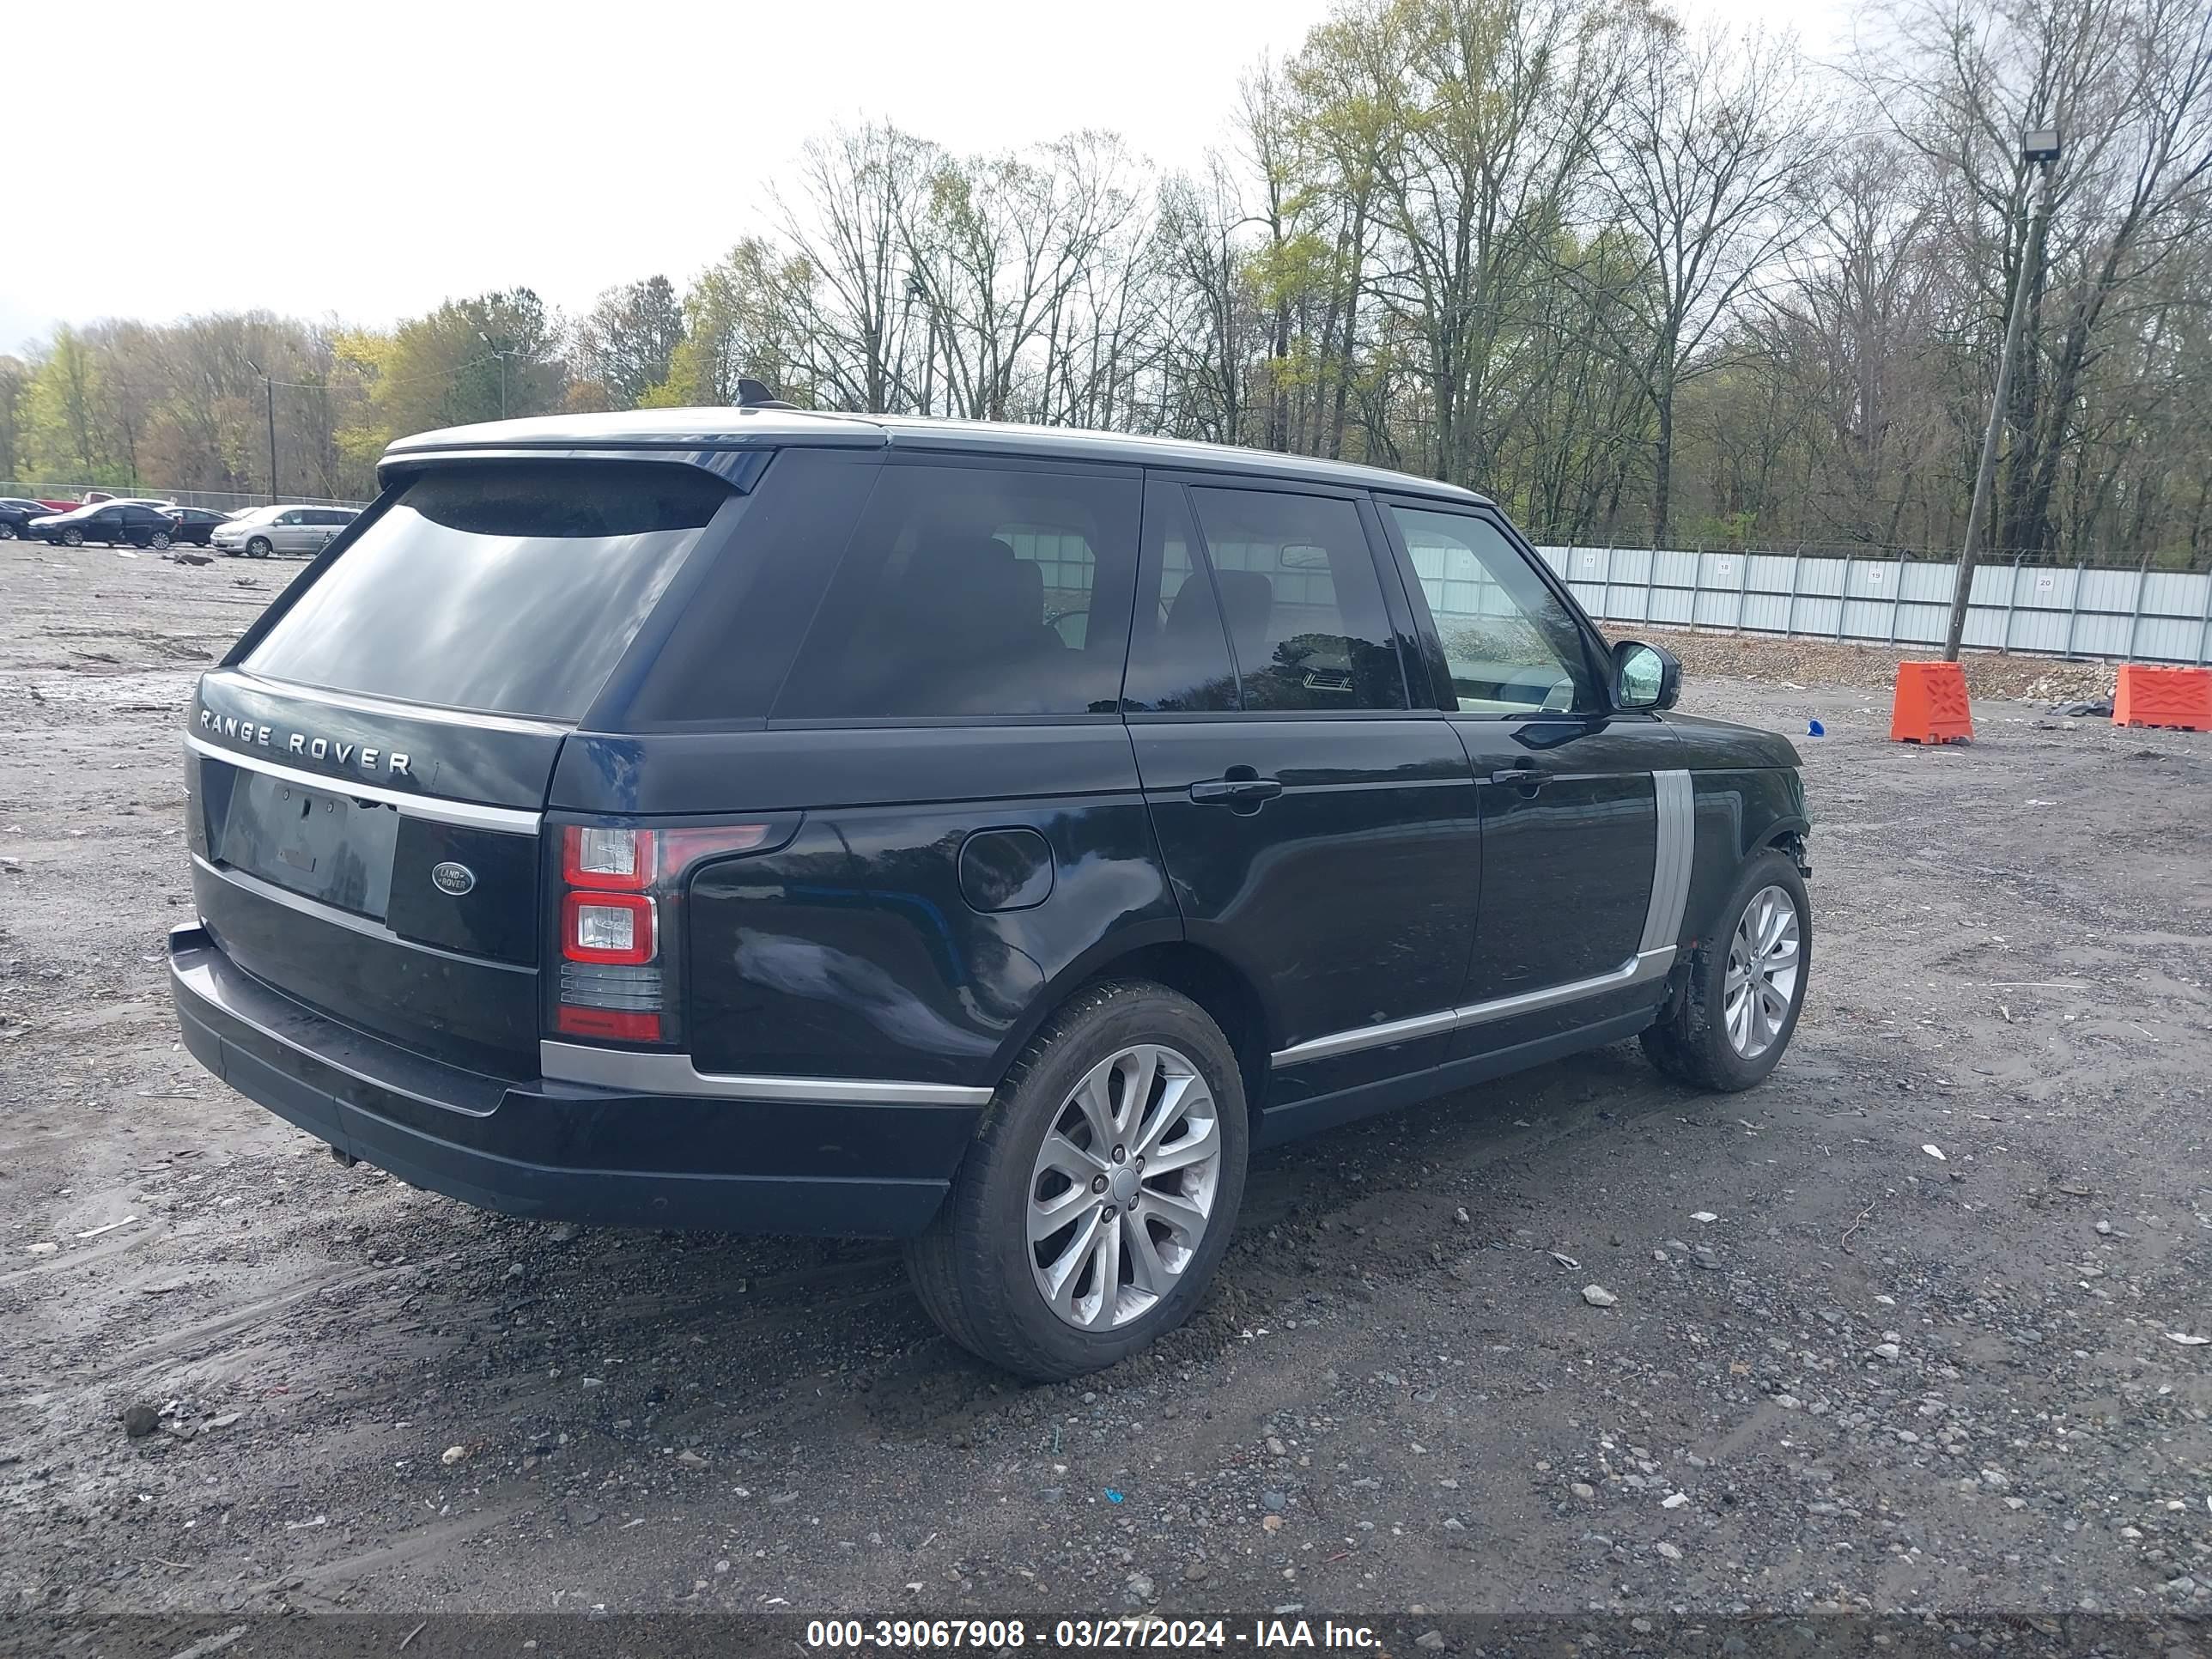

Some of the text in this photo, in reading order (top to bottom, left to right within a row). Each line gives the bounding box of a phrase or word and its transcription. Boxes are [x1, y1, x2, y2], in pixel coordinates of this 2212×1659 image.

[200, 709, 412, 776] RANGE ROVER
[440, 868, 460, 879] LAND
[441, 877, 466, 890] ROVER
